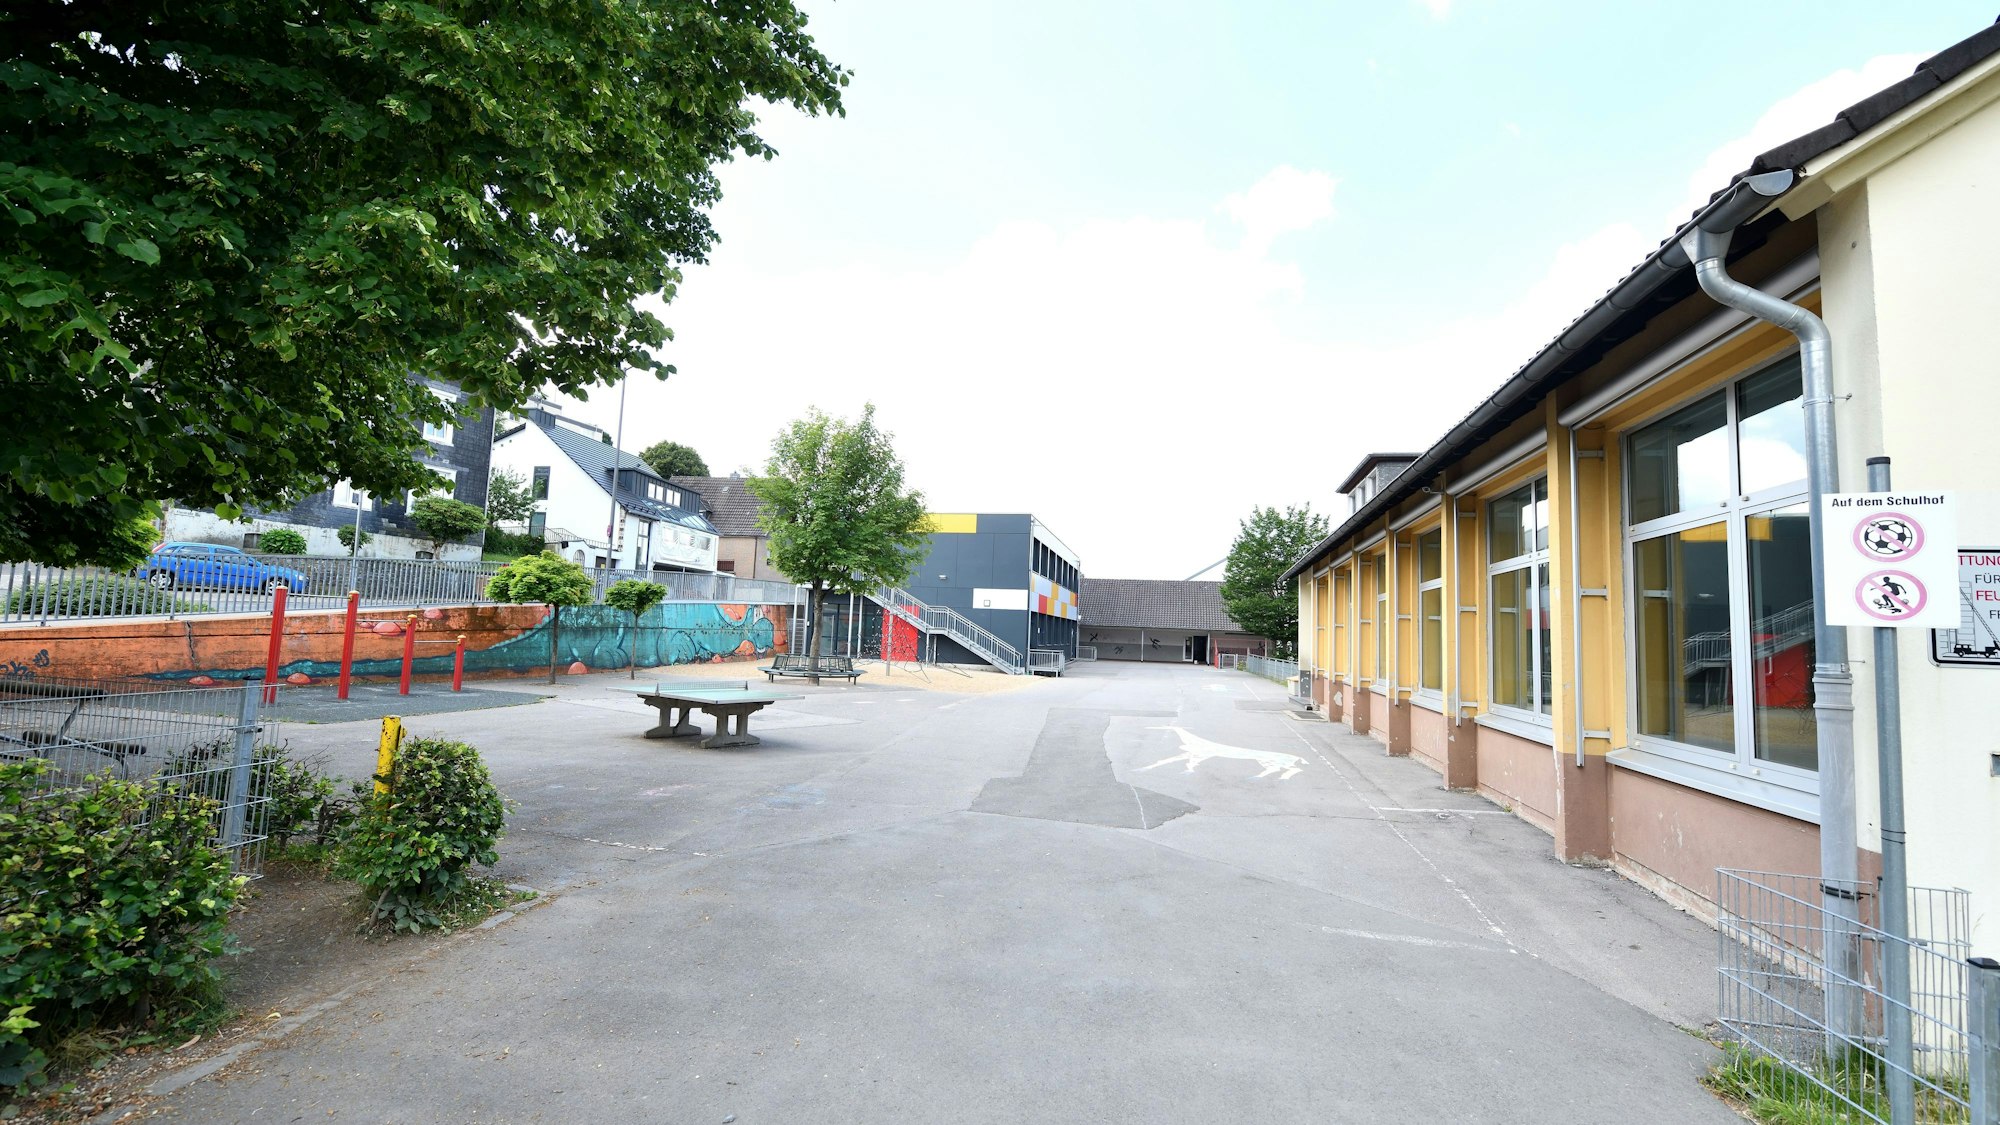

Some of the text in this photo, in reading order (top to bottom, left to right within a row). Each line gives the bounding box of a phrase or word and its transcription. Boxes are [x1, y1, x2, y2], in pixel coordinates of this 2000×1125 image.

[1831, 495, 1945, 507] Auf dem Schulhof
[1974, 572, 2000, 584] FÜR
